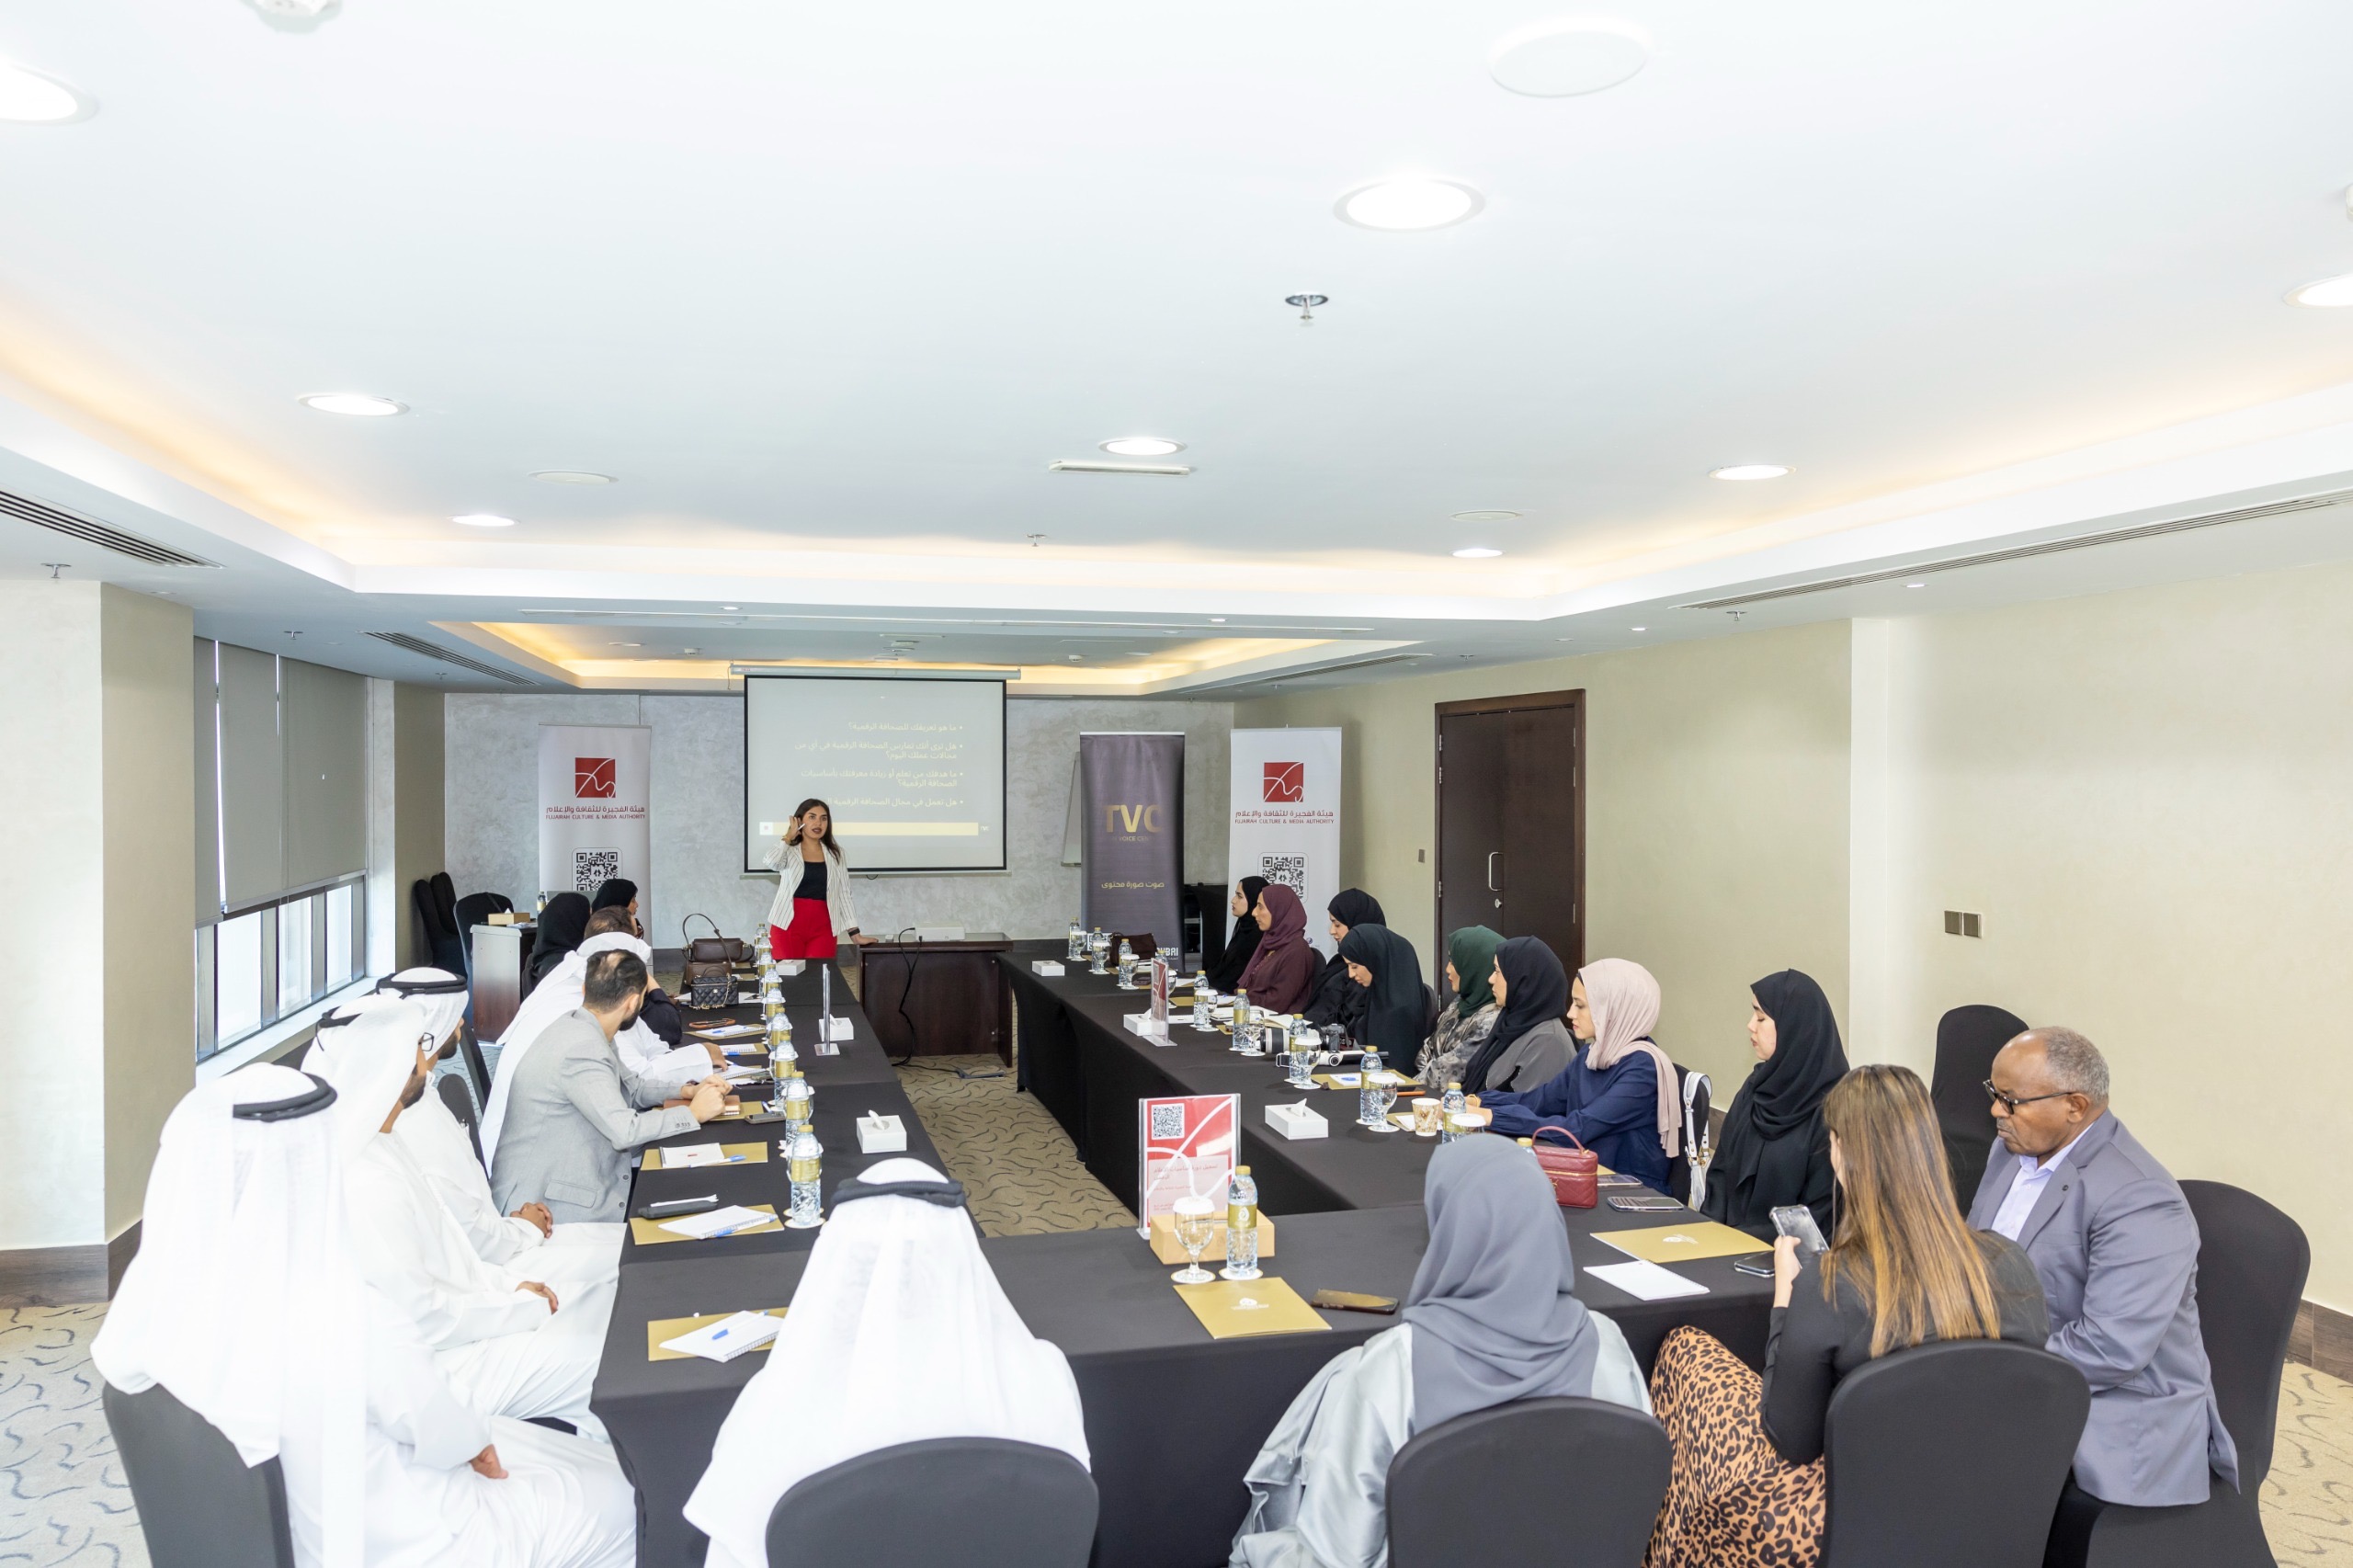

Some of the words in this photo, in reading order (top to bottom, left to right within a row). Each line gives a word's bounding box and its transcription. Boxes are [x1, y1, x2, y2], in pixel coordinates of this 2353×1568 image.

[630, 805, 645, 813] هيئة
[1263, 809, 1289, 817] للثقافة
[1290, 811, 1315, 819] الفجيرة
[1316, 810, 1334, 818] هيئة
[1101, 881, 1125, 890] محتوى
[1126, 881, 1144, 890] صورة
[1145, 881, 1165, 890] صوت
